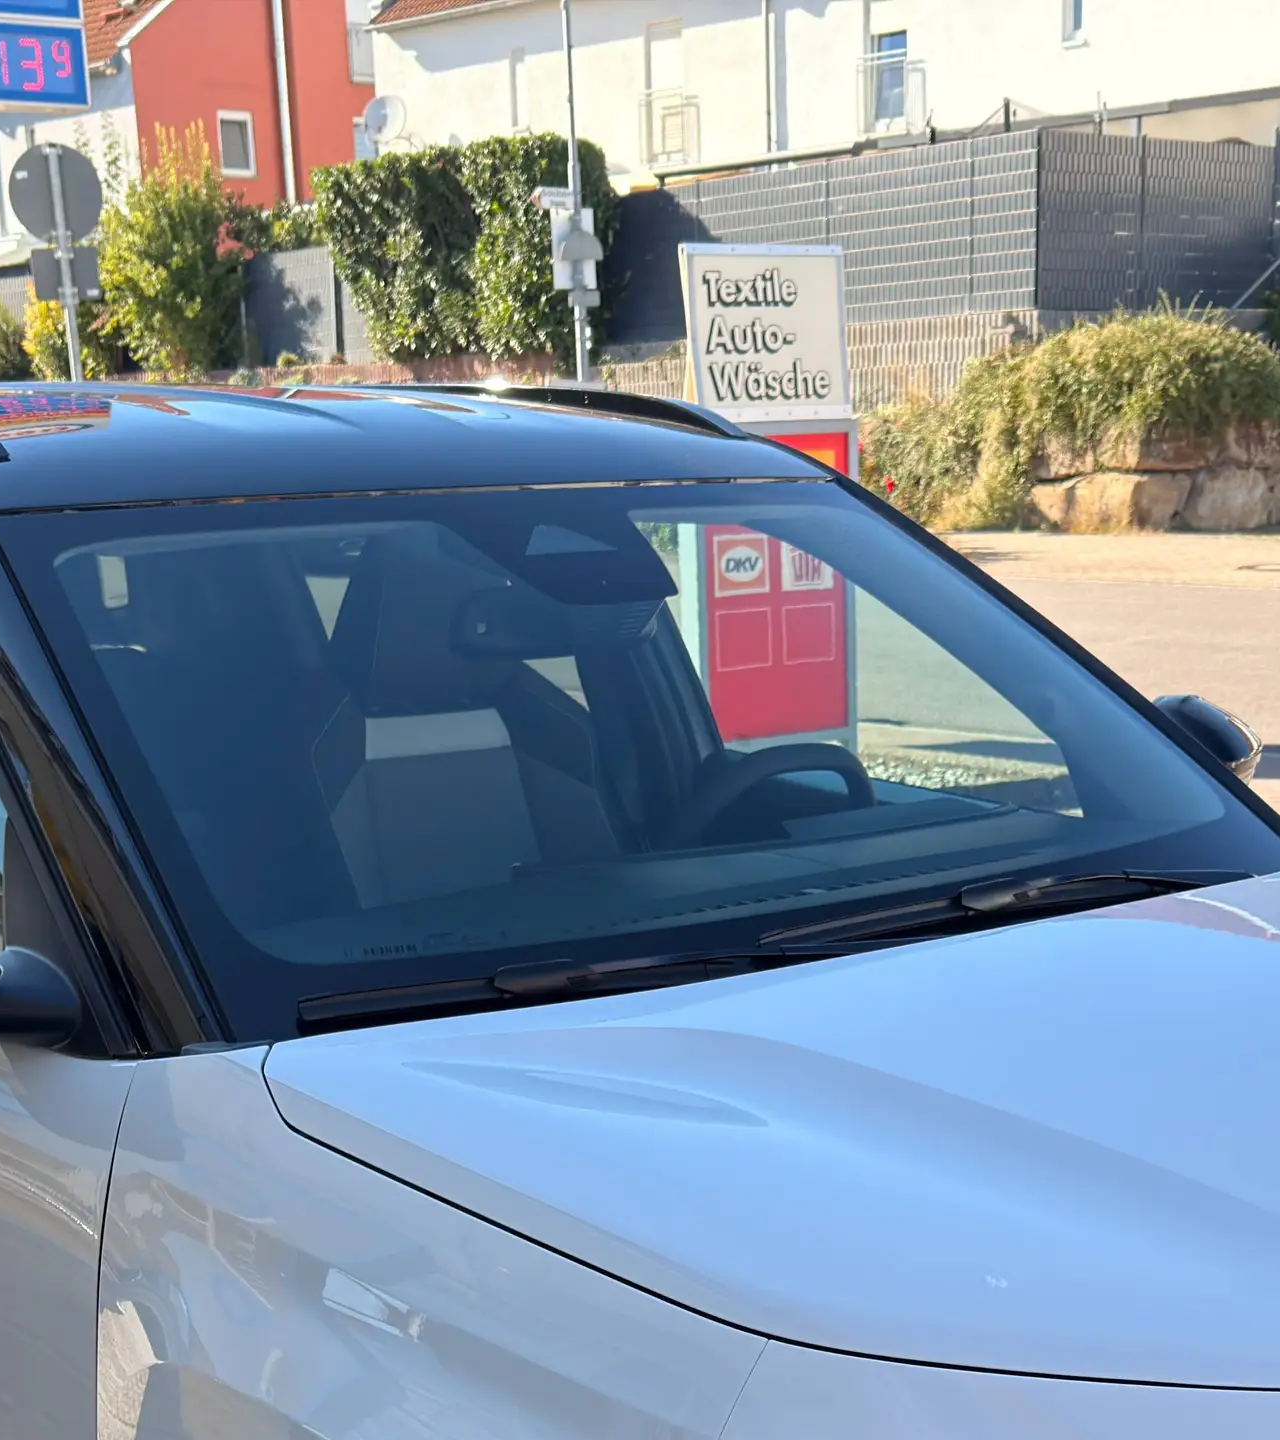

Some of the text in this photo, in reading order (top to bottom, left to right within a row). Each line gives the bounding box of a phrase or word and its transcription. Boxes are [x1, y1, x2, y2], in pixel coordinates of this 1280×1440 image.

[702, 267, 799, 308] Textile
[705, 314, 798, 355] Auto-
[708, 356, 832, 402] Wäsche
[723, 554, 763, 575] DKV
